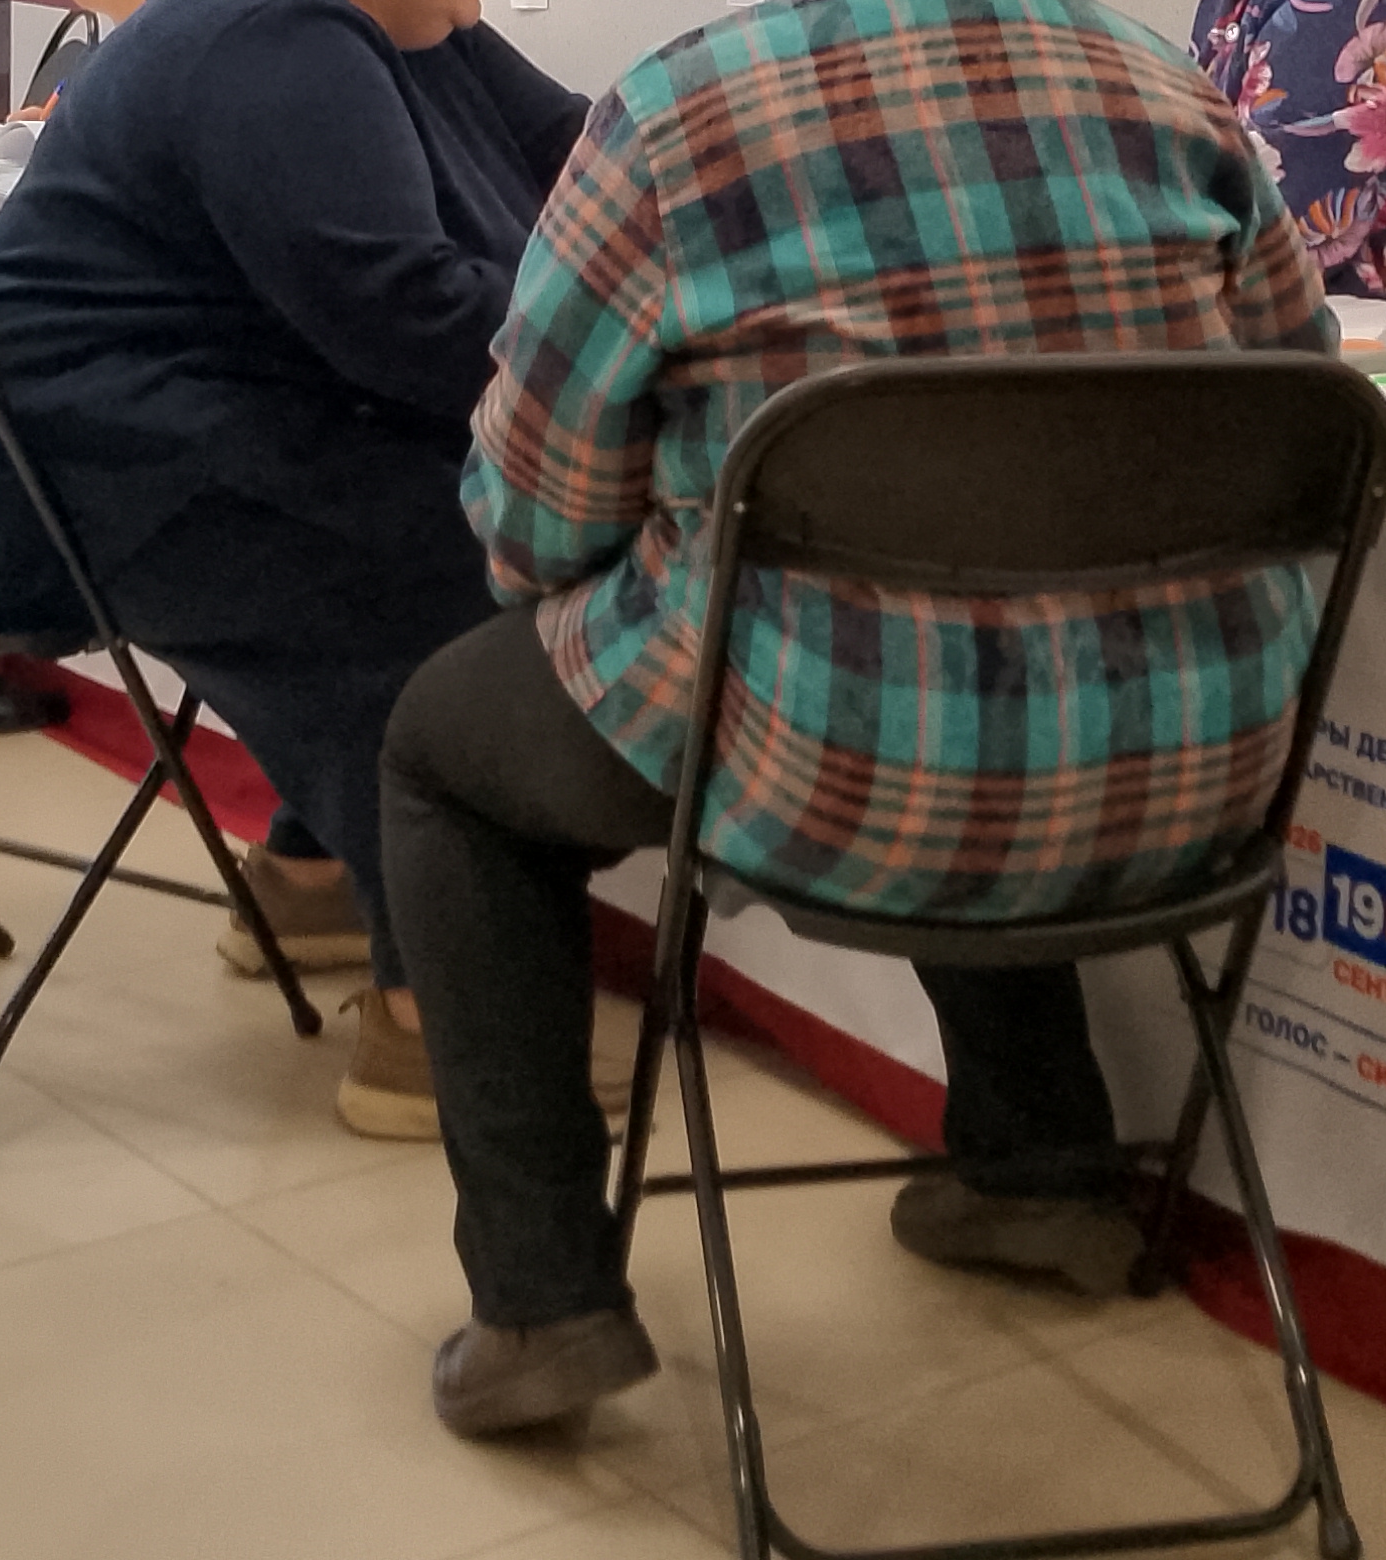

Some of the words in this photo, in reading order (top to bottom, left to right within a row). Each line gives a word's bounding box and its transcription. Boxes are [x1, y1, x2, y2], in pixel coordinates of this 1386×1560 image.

[1273, 874, 1320, 941] 18
[1332, 874, 1385, 940] 19
[1245, 1002, 1328, 1057] ГОЛОС
